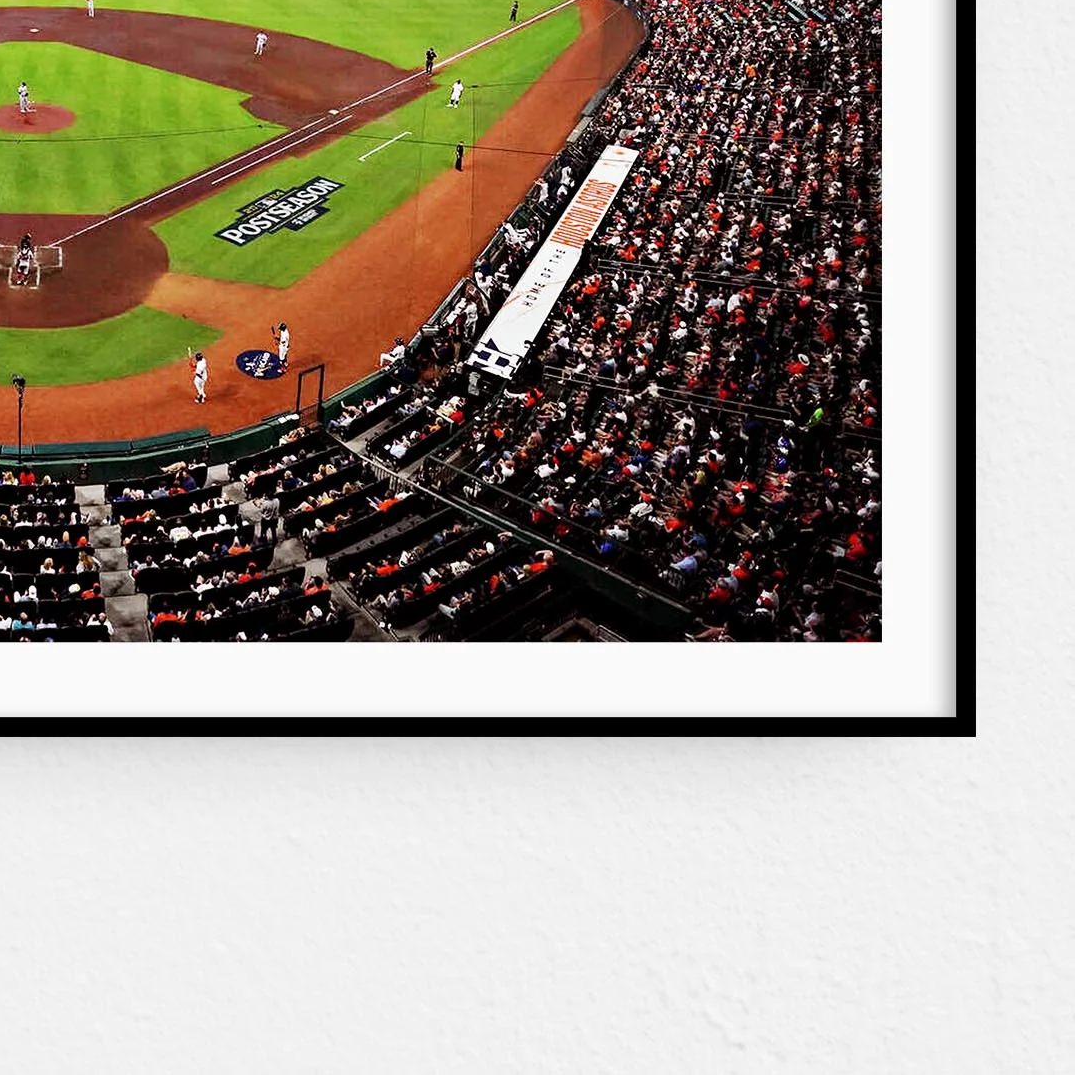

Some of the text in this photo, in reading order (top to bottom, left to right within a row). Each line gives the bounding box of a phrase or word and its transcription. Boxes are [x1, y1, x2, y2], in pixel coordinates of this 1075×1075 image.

[220, 179, 340, 244] POSTSEASON
[549, 205, 602, 250] HOUSTON
[578, 178, 618, 215] ASTROS
